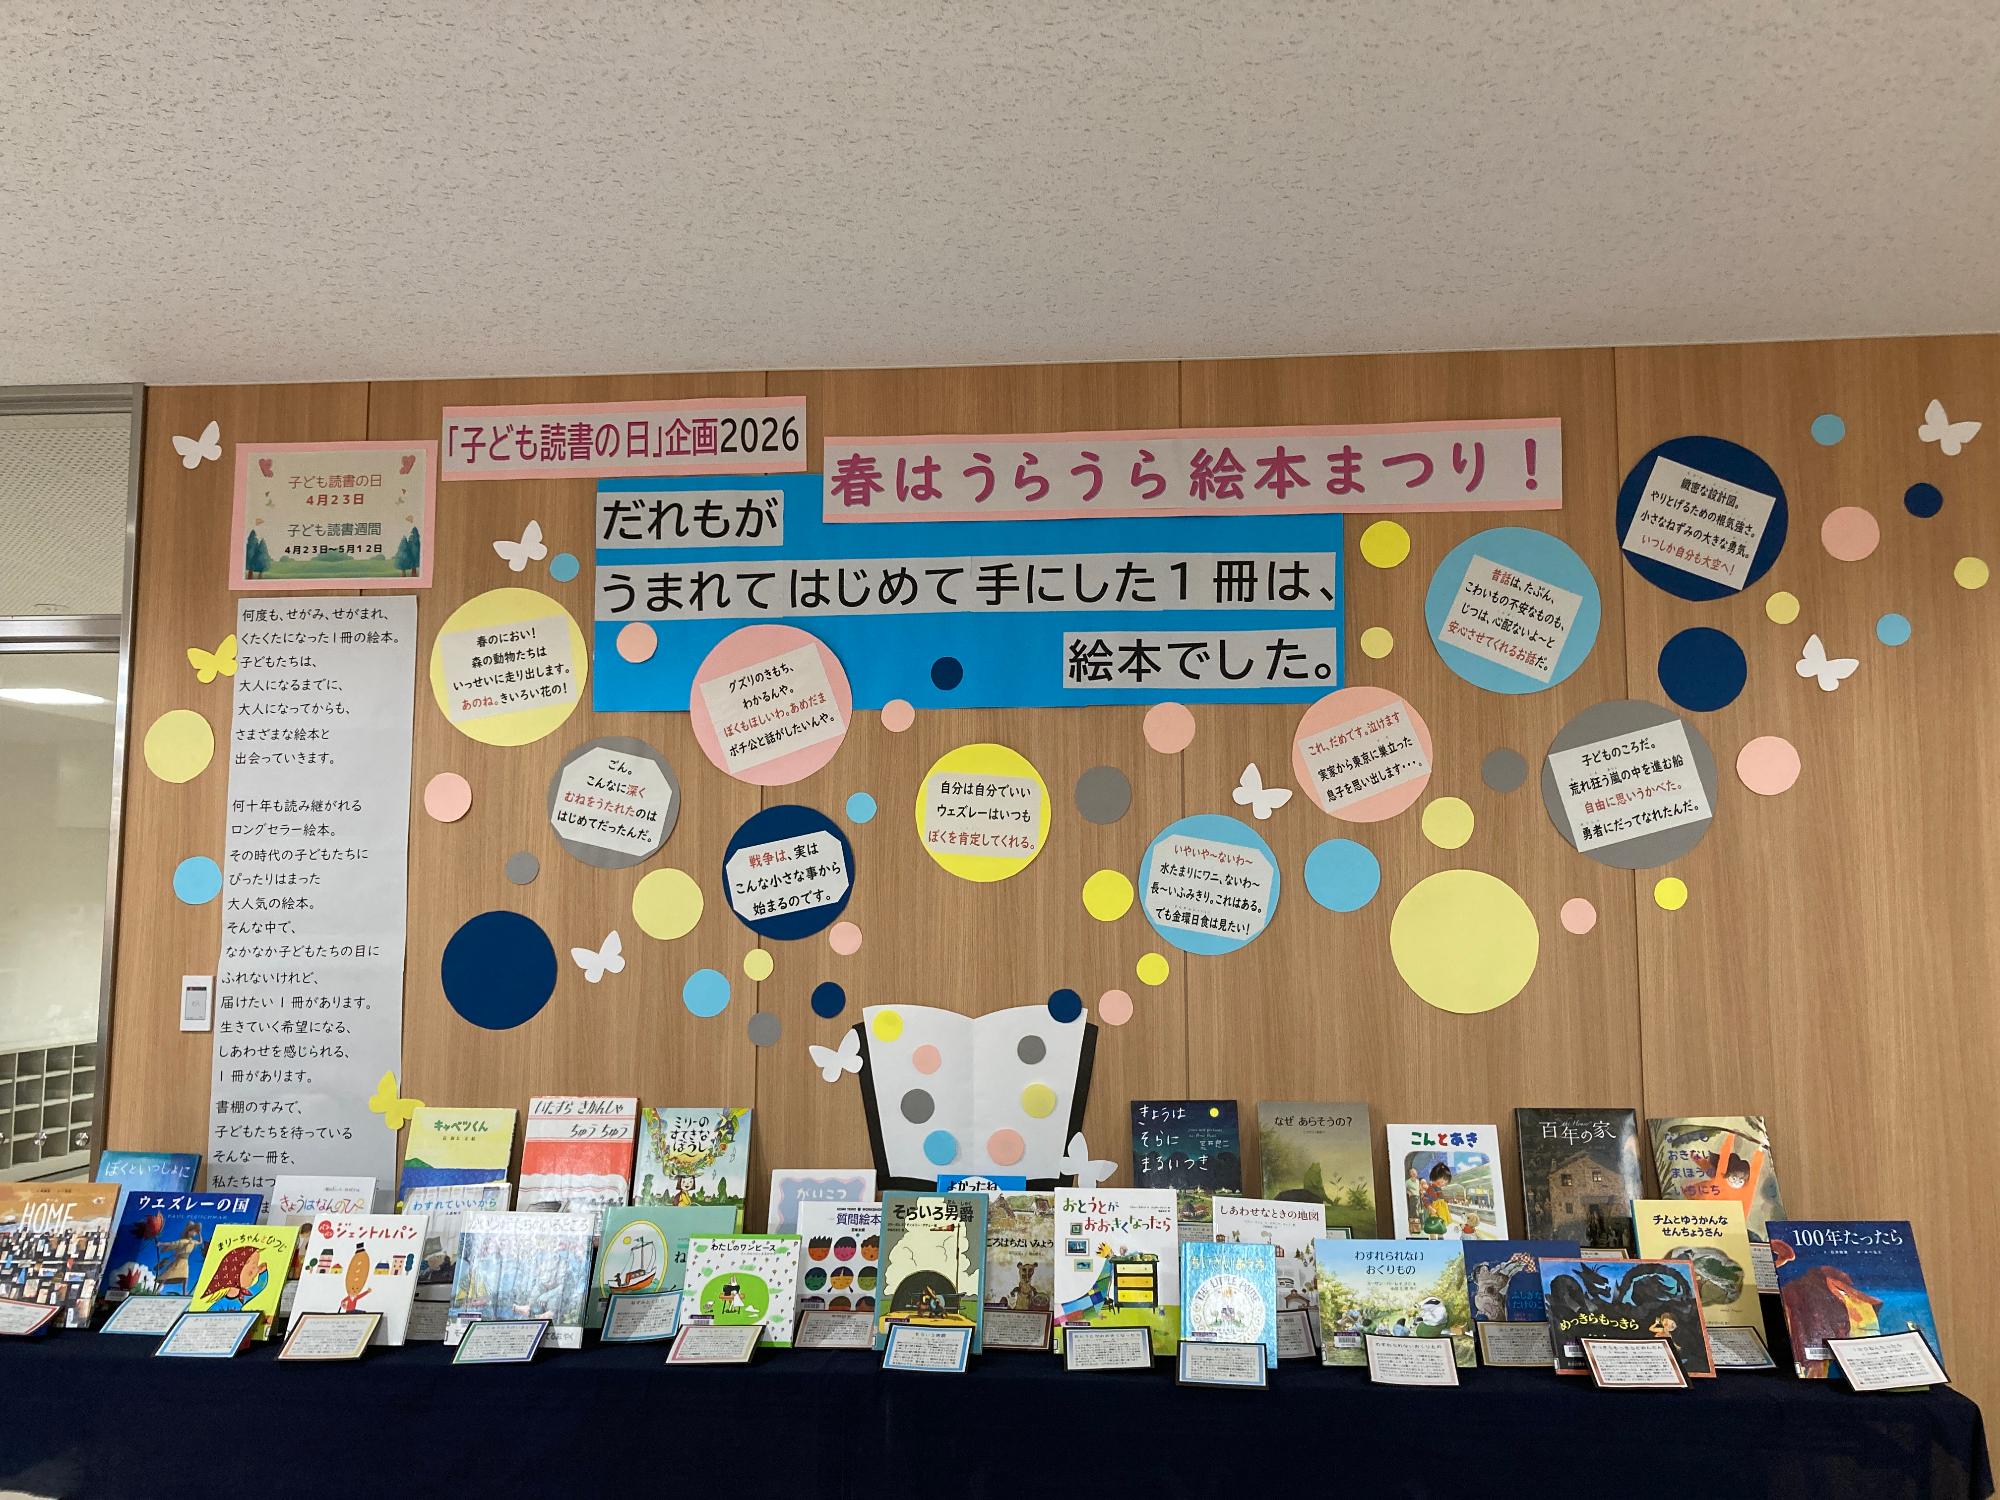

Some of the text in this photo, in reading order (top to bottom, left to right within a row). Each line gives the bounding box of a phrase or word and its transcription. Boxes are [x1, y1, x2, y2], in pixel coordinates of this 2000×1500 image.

[448, 415, 800, 464] 「子ども読書の日」企画2026
[288, 474, 382, 489] 子ども読書の日
[831, 438, 1538, 508] 春はうらうら絵本まつり！
[1680, 477, 1739, 510] 緻密な設計図。
[602, 498, 778, 541] だれもが
[1650, 490, 1755, 538] やりとげるための根気強さ。
[287, 522, 382, 538] 子ども読書週間
[1640, 510, 1750, 559] 小さなねずみの大きな勇気。
[1641, 534, 1735, 576] いつしか自分も大空へ！
[602, 557, 1336, 614] うまれてはじめて手にした1冊は、
[1491, 568, 1554, 604] 昔話は、たぶん、
[243, 608, 389, 622] 何度も、せがみ、せがまれ、
[1465, 581, 1564, 632] こわいもの不安なものも、
[477, 627, 536, 647] 春のにおい！
[1447, 620, 1548, 671] 安心させてくれるお話だ。
[240, 656, 317, 668] 子どもたちは、
[471, 646, 547, 668] 森の動物たちは
[1068, 639, 1332, 683] 絵本でした。
[239, 679, 343, 692] 大人になるまでに、
[453, 663, 569, 690] いっせいに走り出します。
[729, 663, 794, 693] グズリのきもち、
[462, 682, 567, 710] あのね。きいろい花の！
[742, 684, 794, 709] わかるんや。
[238, 702, 351, 716] 大人になってからも、
[724, 692, 826, 737] ぼくもほしいわ。あめだま
[236, 728, 330, 741] さまざまな絵本と
[1308, 711, 1400, 756] これ、だめです。泣けます
[235, 752, 335, 765] 出会っていきます。
[1318, 736, 1413, 782] 実家から東京に巣立った
[1582, 737, 1656, 767] 子どものころだ。
[608, 760, 632, 775] ごん。
[1569, 754, 1684, 797] 荒れ狂う嵐の中を進む船
[587, 775, 647, 798] こんなに深く
[941, 781, 1031, 797] 自分は自分でいい
[232, 799, 362, 813] 何十年も読み継がれる
[564, 791, 657, 821] むねをうたれたのは
[1584, 780, 1683, 815] 自由に思いうかべた。
[558, 810, 652, 842] はじめてだったんだ。
[1582, 799, 1699, 841] 勇者にだってなれたんだ。
[232, 822, 337, 837] ロングセラー絵本。
[928, 829, 1035, 849] ぼくを肯定してくれる。
[229, 848, 368, 862] その時代の子どもたちに
[748, 842, 819, 868] 戦争は、実は
[229, 873, 320, 886] ぴったりはまった
[736, 862, 841, 894] こんな小さな事から
[228, 897, 315, 910] 大人気の絵本。
[753, 889, 831, 916] 始まるのです。
[227, 921, 297, 934] そんな中で、
[226, 945, 380, 958] なかなか子どもたちの目に
[221, 972, 319, 985] ふれないけれど、
[220, 1020, 352, 1034] 生きていく希望になる、
[219, 1045, 350, 1058] しあわせを感じられる、
[216, 1100, 302, 1114] 書棚のすみで、
[1138, 1104, 1186, 1125] きょうは
[434, 1120, 488, 1132] キャベツくん
[674, 1116, 710, 1128] ミリーの
[1274, 1116, 1353, 1127] なぜ あらそうの?
[215, 1126, 352, 1140] 子どもたちを待っている
[671, 1129, 710, 1142] すてきな
[1140, 1130, 1179, 1147] そらに
[1411, 1131, 1478, 1148] こんとあき
[1539, 1121, 1617, 1146] 百年の家
[673, 1141, 708, 1153] ぼうし
[213, 1150, 295, 1164] そんな一冊を、
[1141, 1155, 1209, 1174] まるいつき
[105, 1159, 190, 1178] ぼくといっしょに
[796, 1188, 847, 1200] がいこつ
[412, 1199, 497, 1212] わすれていいから
[893, 1204, 974, 1222] そらいろ男爵
[1063, 1197, 1119, 1215] おとうとが
[1220, 1205, 1319, 1221] しあわせなときの地図
[836, 1212, 881, 1225] 質問絵本
[1084, 1215, 1171, 1233] おおきくなったら
[1653, 1214, 1728, 1226] チムとゆうかんな
[1662, 1227, 1723, 1238] せんちょうさん
[1792, 1229, 1903, 1247] 100年たったら
[710, 1243, 776, 1252] わたしのワンピース
[1355, 1250, 1424, 1262] わすれられない
[1366, 1265, 1415, 1276] おくりもの
[1559, 1313, 1639, 1331] めっきらもっきら
